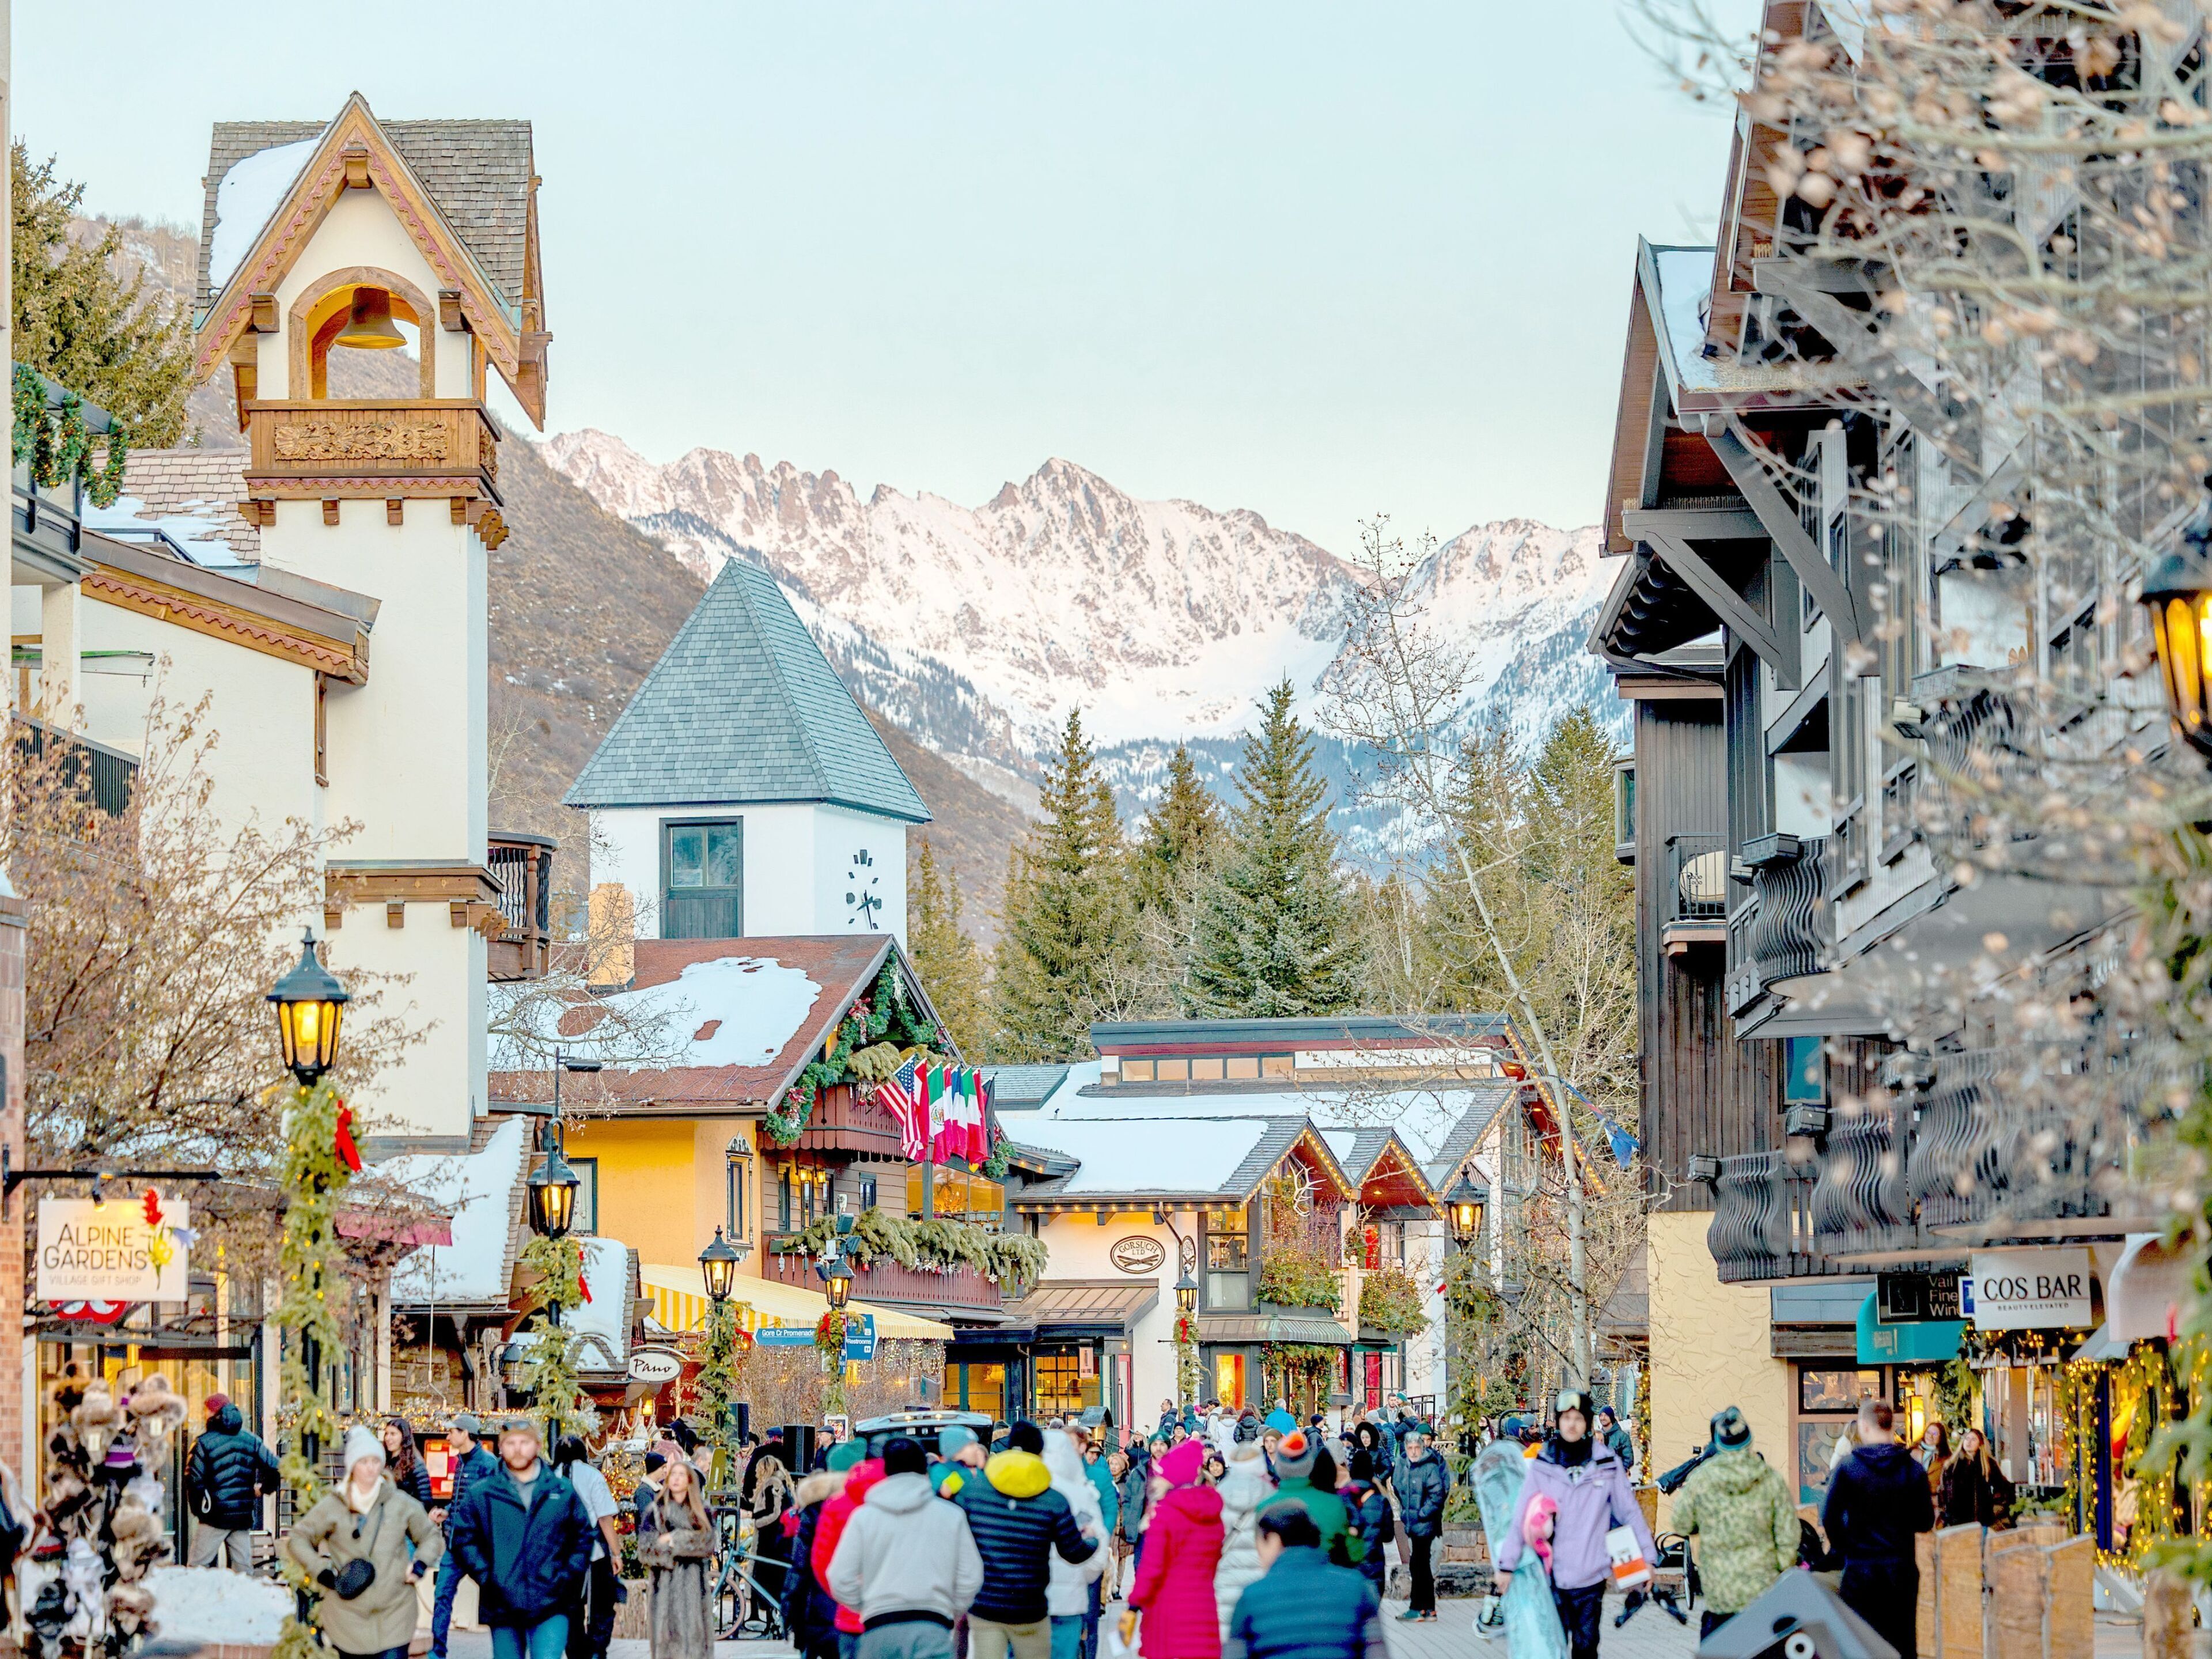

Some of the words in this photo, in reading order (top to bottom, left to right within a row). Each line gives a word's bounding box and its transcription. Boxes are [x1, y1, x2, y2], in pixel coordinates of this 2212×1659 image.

[58, 1223, 134, 1247] ALPINE
[1119, 1240, 1158, 1254] GORSUCH
[44, 1245, 148, 1270] GARDENS
[48, 1275, 87, 1286] VILLAGE
[91, 1275, 112, 1285] GIFT
[115, 1275, 142, 1286] SHOP
[1927, 1274, 1953, 1287] Vail
[1984, 1276, 2028, 1301] COS
[2036, 1274, 2081, 1299] BAR
[1930, 1289, 1958, 1302] Fine
